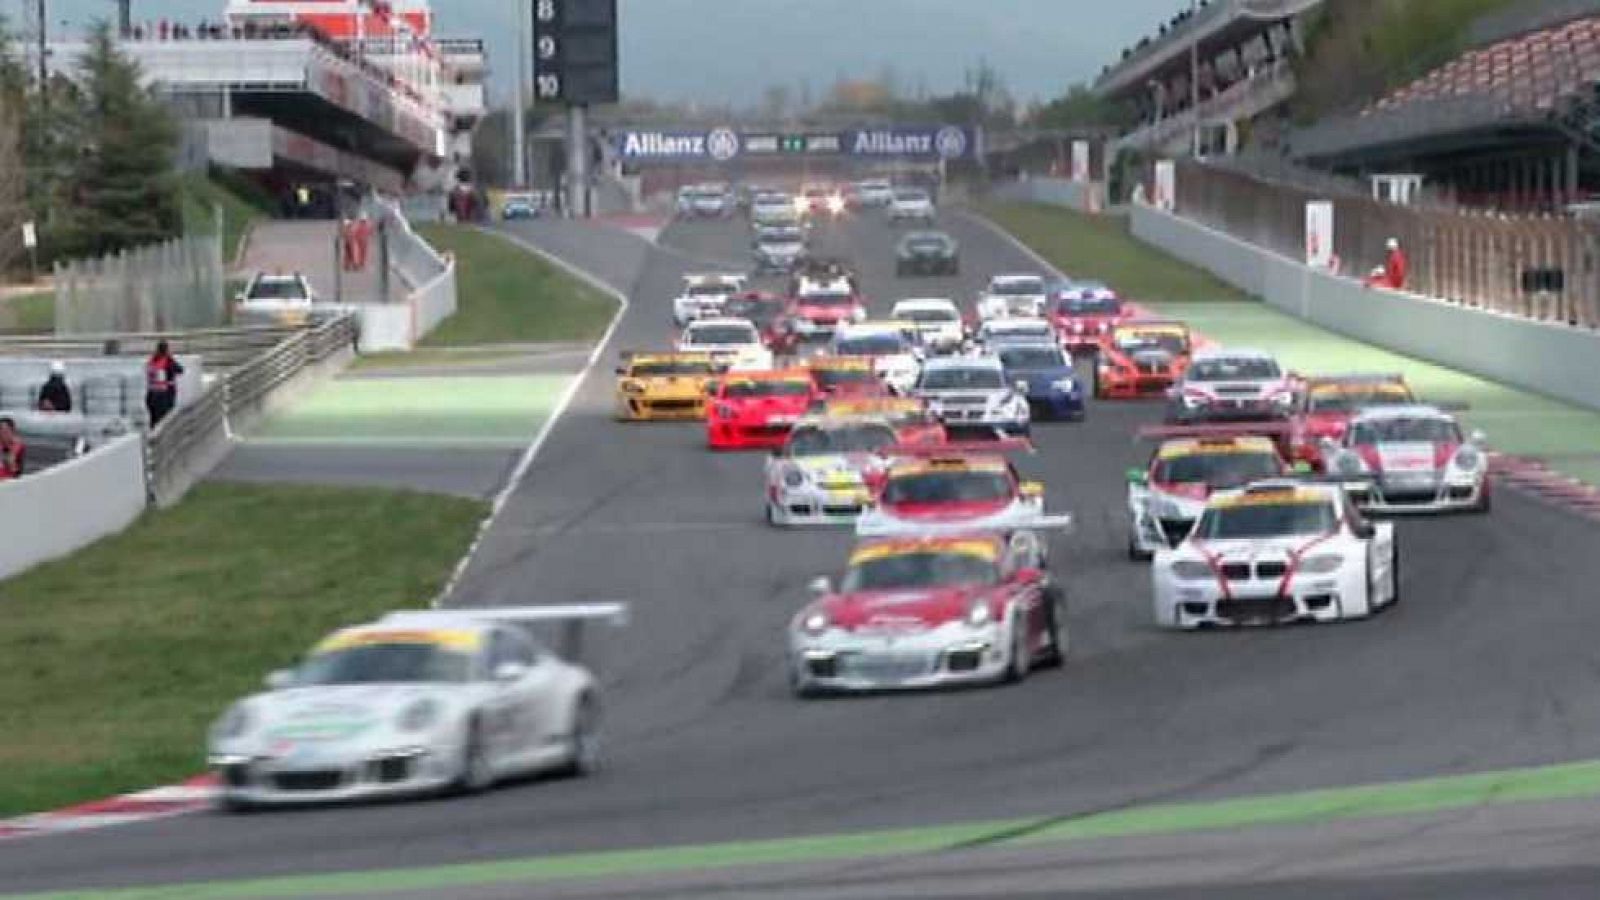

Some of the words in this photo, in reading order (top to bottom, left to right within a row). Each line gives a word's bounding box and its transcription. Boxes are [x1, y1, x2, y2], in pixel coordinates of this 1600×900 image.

[538, 0, 554, 20] 8
[538, 36, 555, 59] 9
[537, 74, 558, 98] 10
[624, 132, 705, 154] Allianz
[854, 130, 932, 153] Allianz
